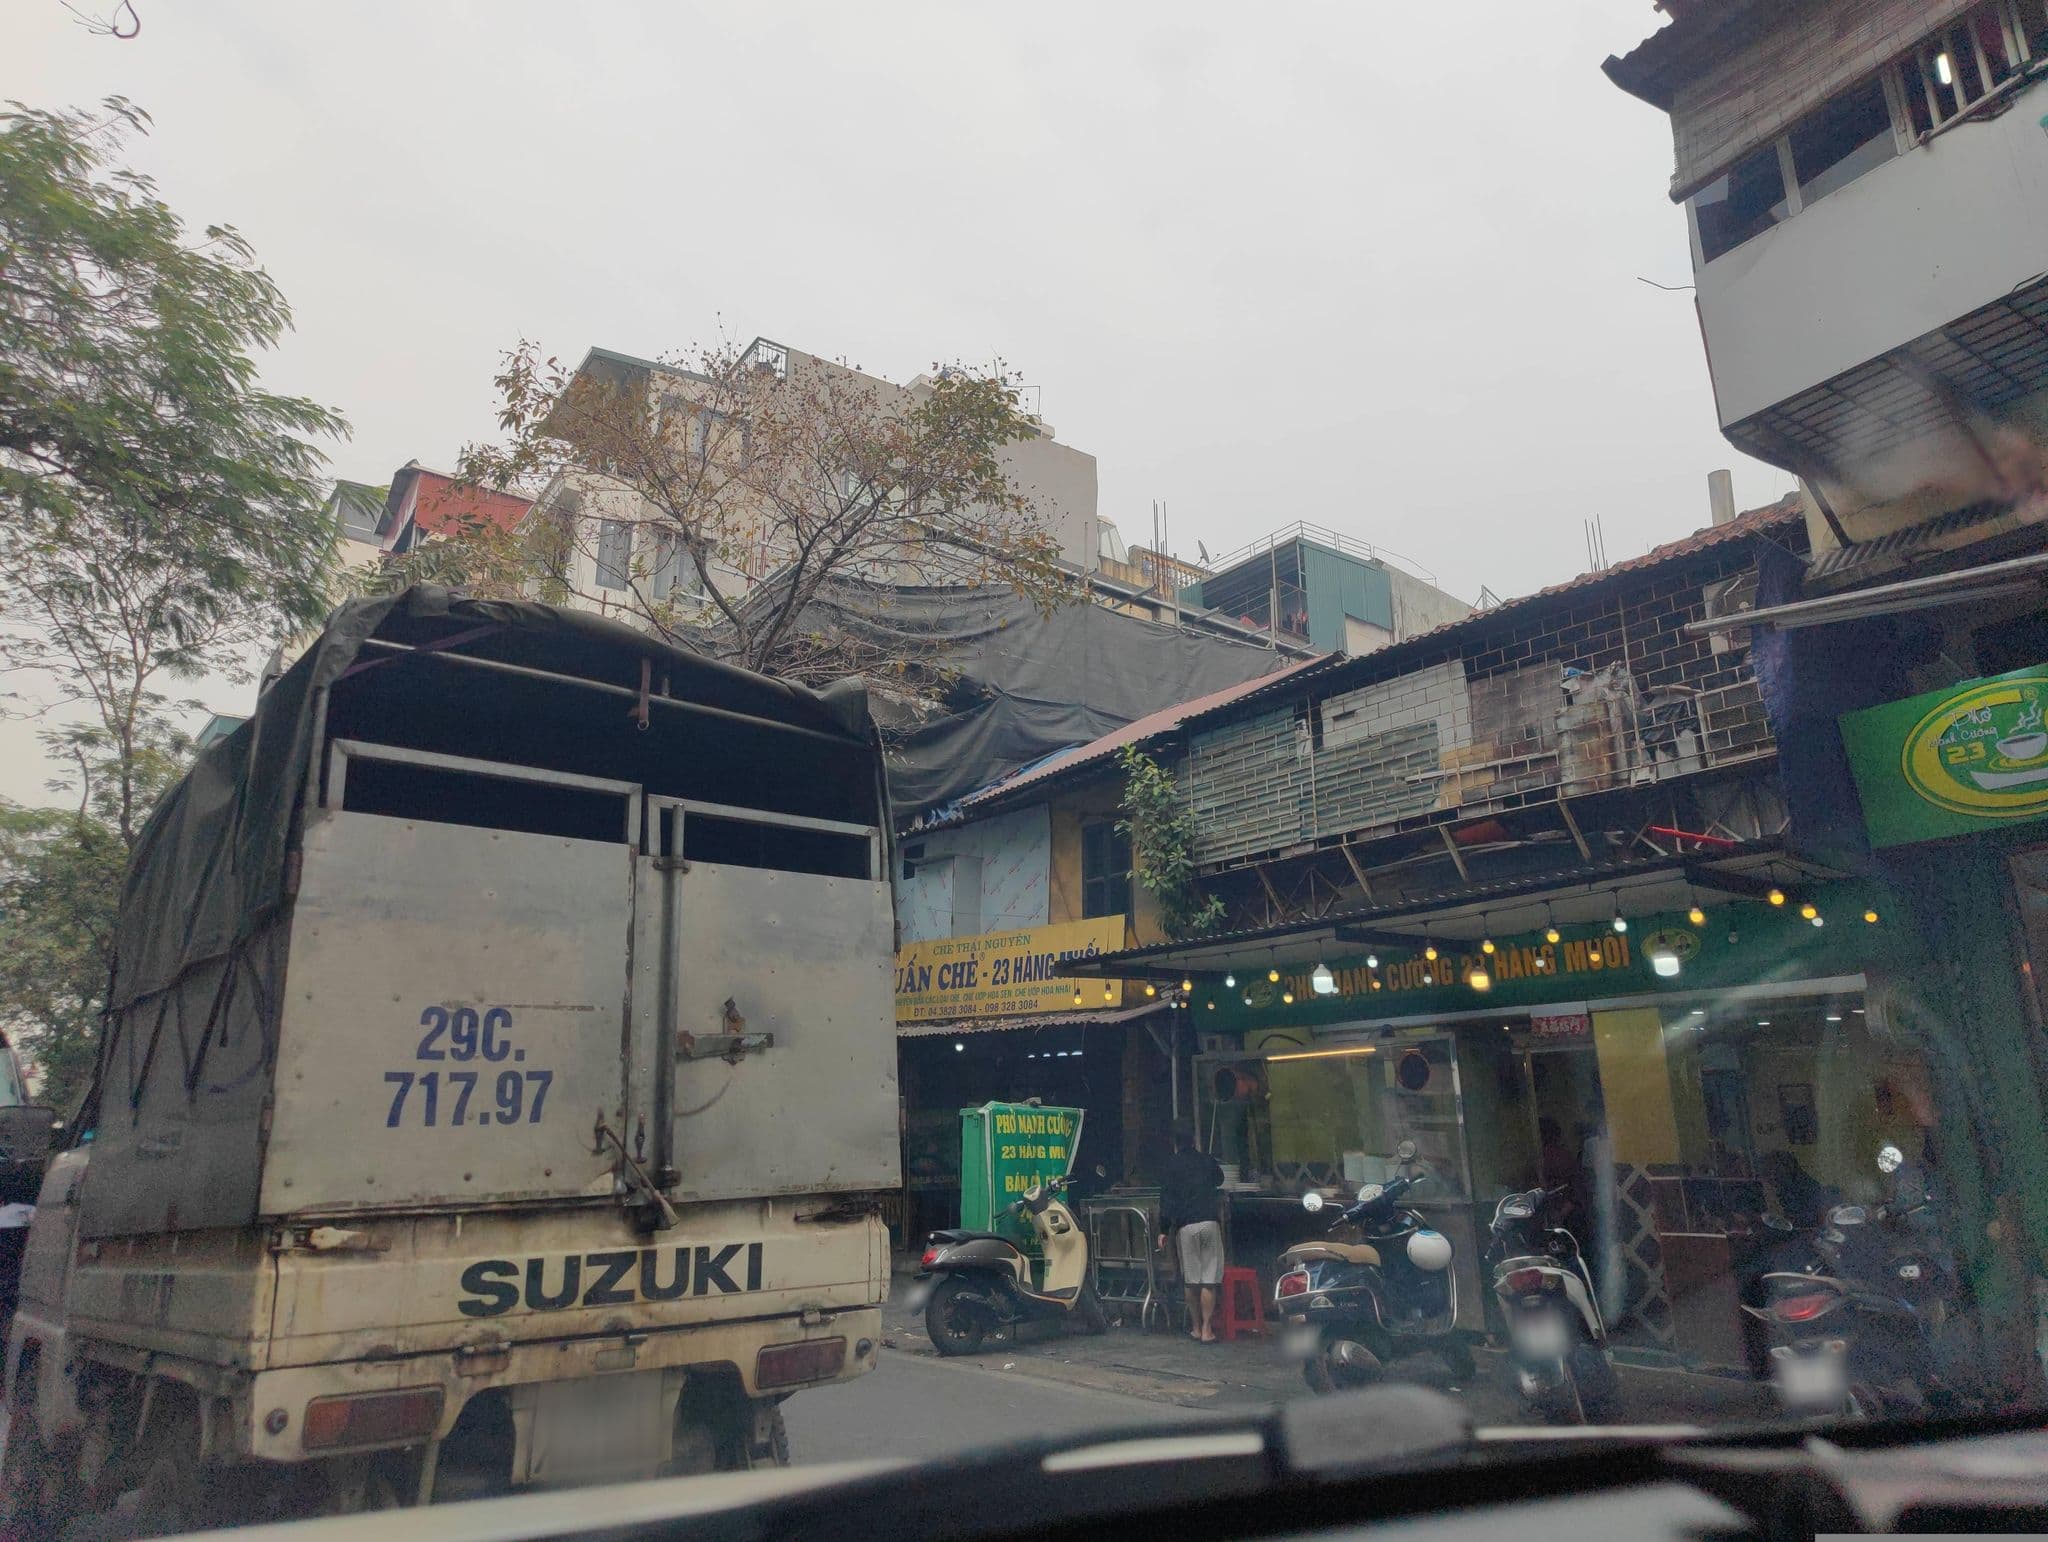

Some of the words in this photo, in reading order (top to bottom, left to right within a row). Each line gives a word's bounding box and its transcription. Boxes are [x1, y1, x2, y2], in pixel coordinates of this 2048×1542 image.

[1946, 741, 1986, 764] 23
[985, 933, 1031, 950] NGUYÊN
[992, 957, 1010, 986] 23
[1013, 950, 1056, 984] HÀNG
[1494, 943, 1557, 980] HÀNG
[985, 1002, 999, 1012] 098
[1001, 1001, 1016, 1011] 328
[1018, 999, 1038, 1010] 3084
[416, 1006, 526, 1062] 29C.
[384, 1070, 553, 1127] 717.97
[1001, 1145, 1017, 1159] 23
[1005, 1172, 1028, 1192] BÁN
[457, 1242, 763, 1317] SUZUKI
